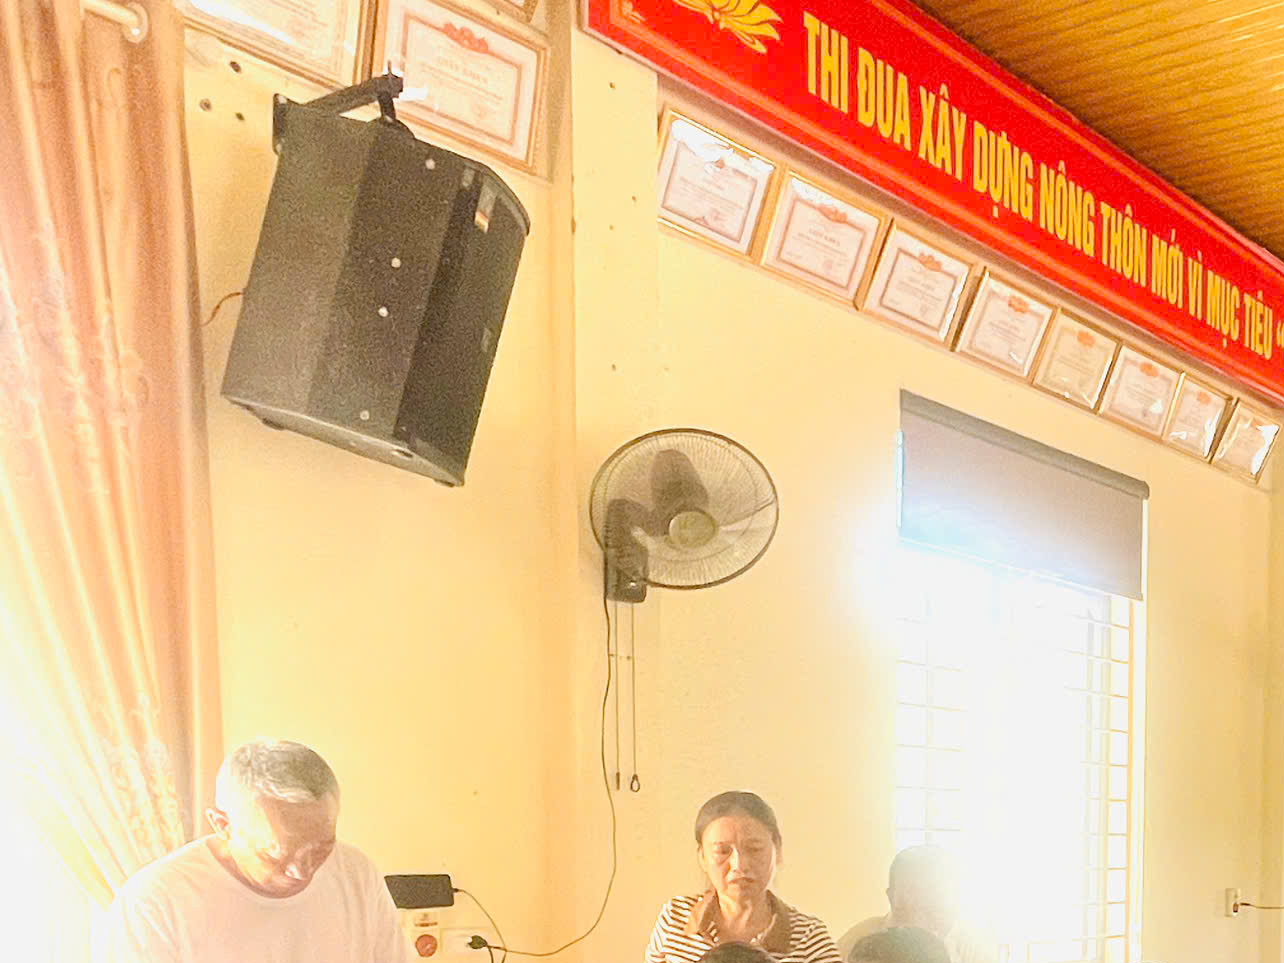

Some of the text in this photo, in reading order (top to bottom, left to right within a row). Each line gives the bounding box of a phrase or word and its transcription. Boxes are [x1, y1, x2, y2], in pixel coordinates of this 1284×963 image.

[803, 10, 849, 115] THI
[857, 47, 912, 151] ĐUA
[918, 83, 967, 182] XÂY
[973, 120, 1034, 222] DỰNG
[1039, 159, 1096, 258] NÔNG
[1100, 201, 1147, 288] THÔN
[1151, 229, 1184, 309] MỚI
[1188, 250, 1204, 321] VÌ
[1206, 269, 1240, 349] MỤC
[1243, 290, 1274, 361] TIÊU
